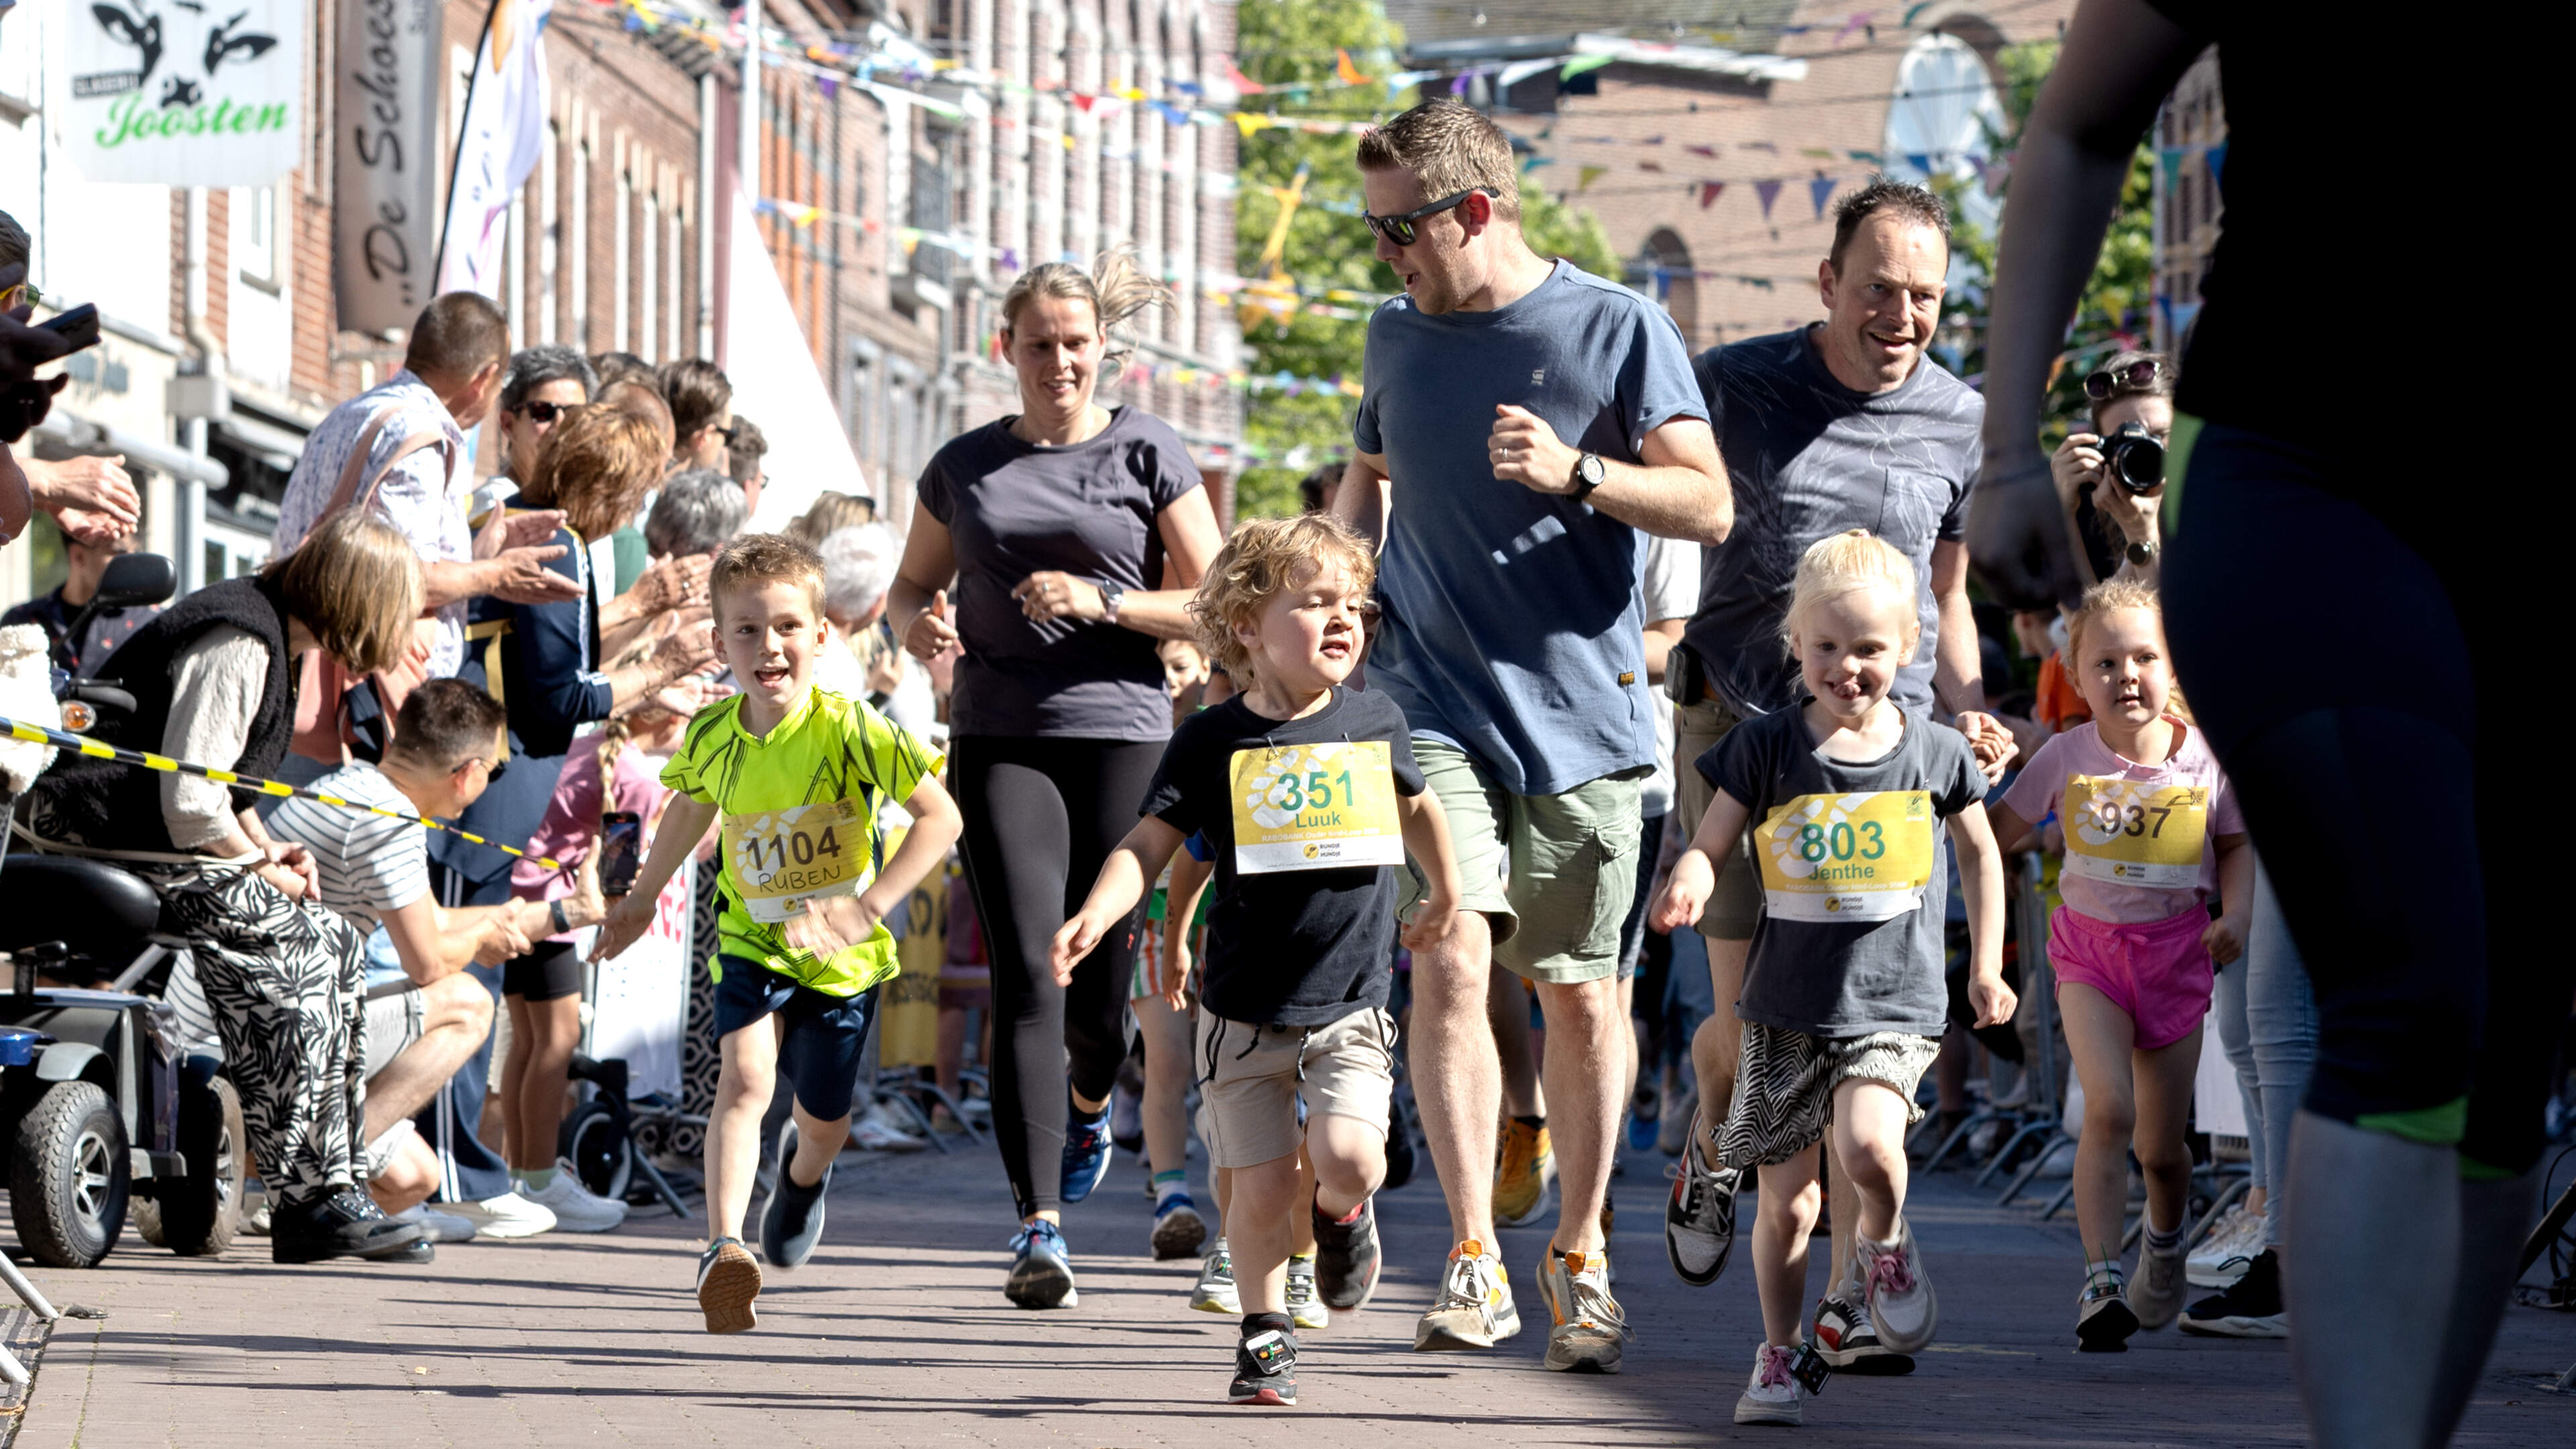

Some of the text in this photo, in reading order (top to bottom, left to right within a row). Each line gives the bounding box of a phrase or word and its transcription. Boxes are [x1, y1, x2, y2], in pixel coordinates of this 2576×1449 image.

[95, 93, 288, 149] Joosten
[1277, 769, 1354, 812] 351
[1295, 810, 1342, 828] Luuk
[2100, 802, 2171, 839] 937
[745, 825, 842, 871] 1104
[1801, 820, 1886, 863] 803
[757, 864, 841, 894] RUBEN
[1809, 863, 1876, 881] Jenthe
